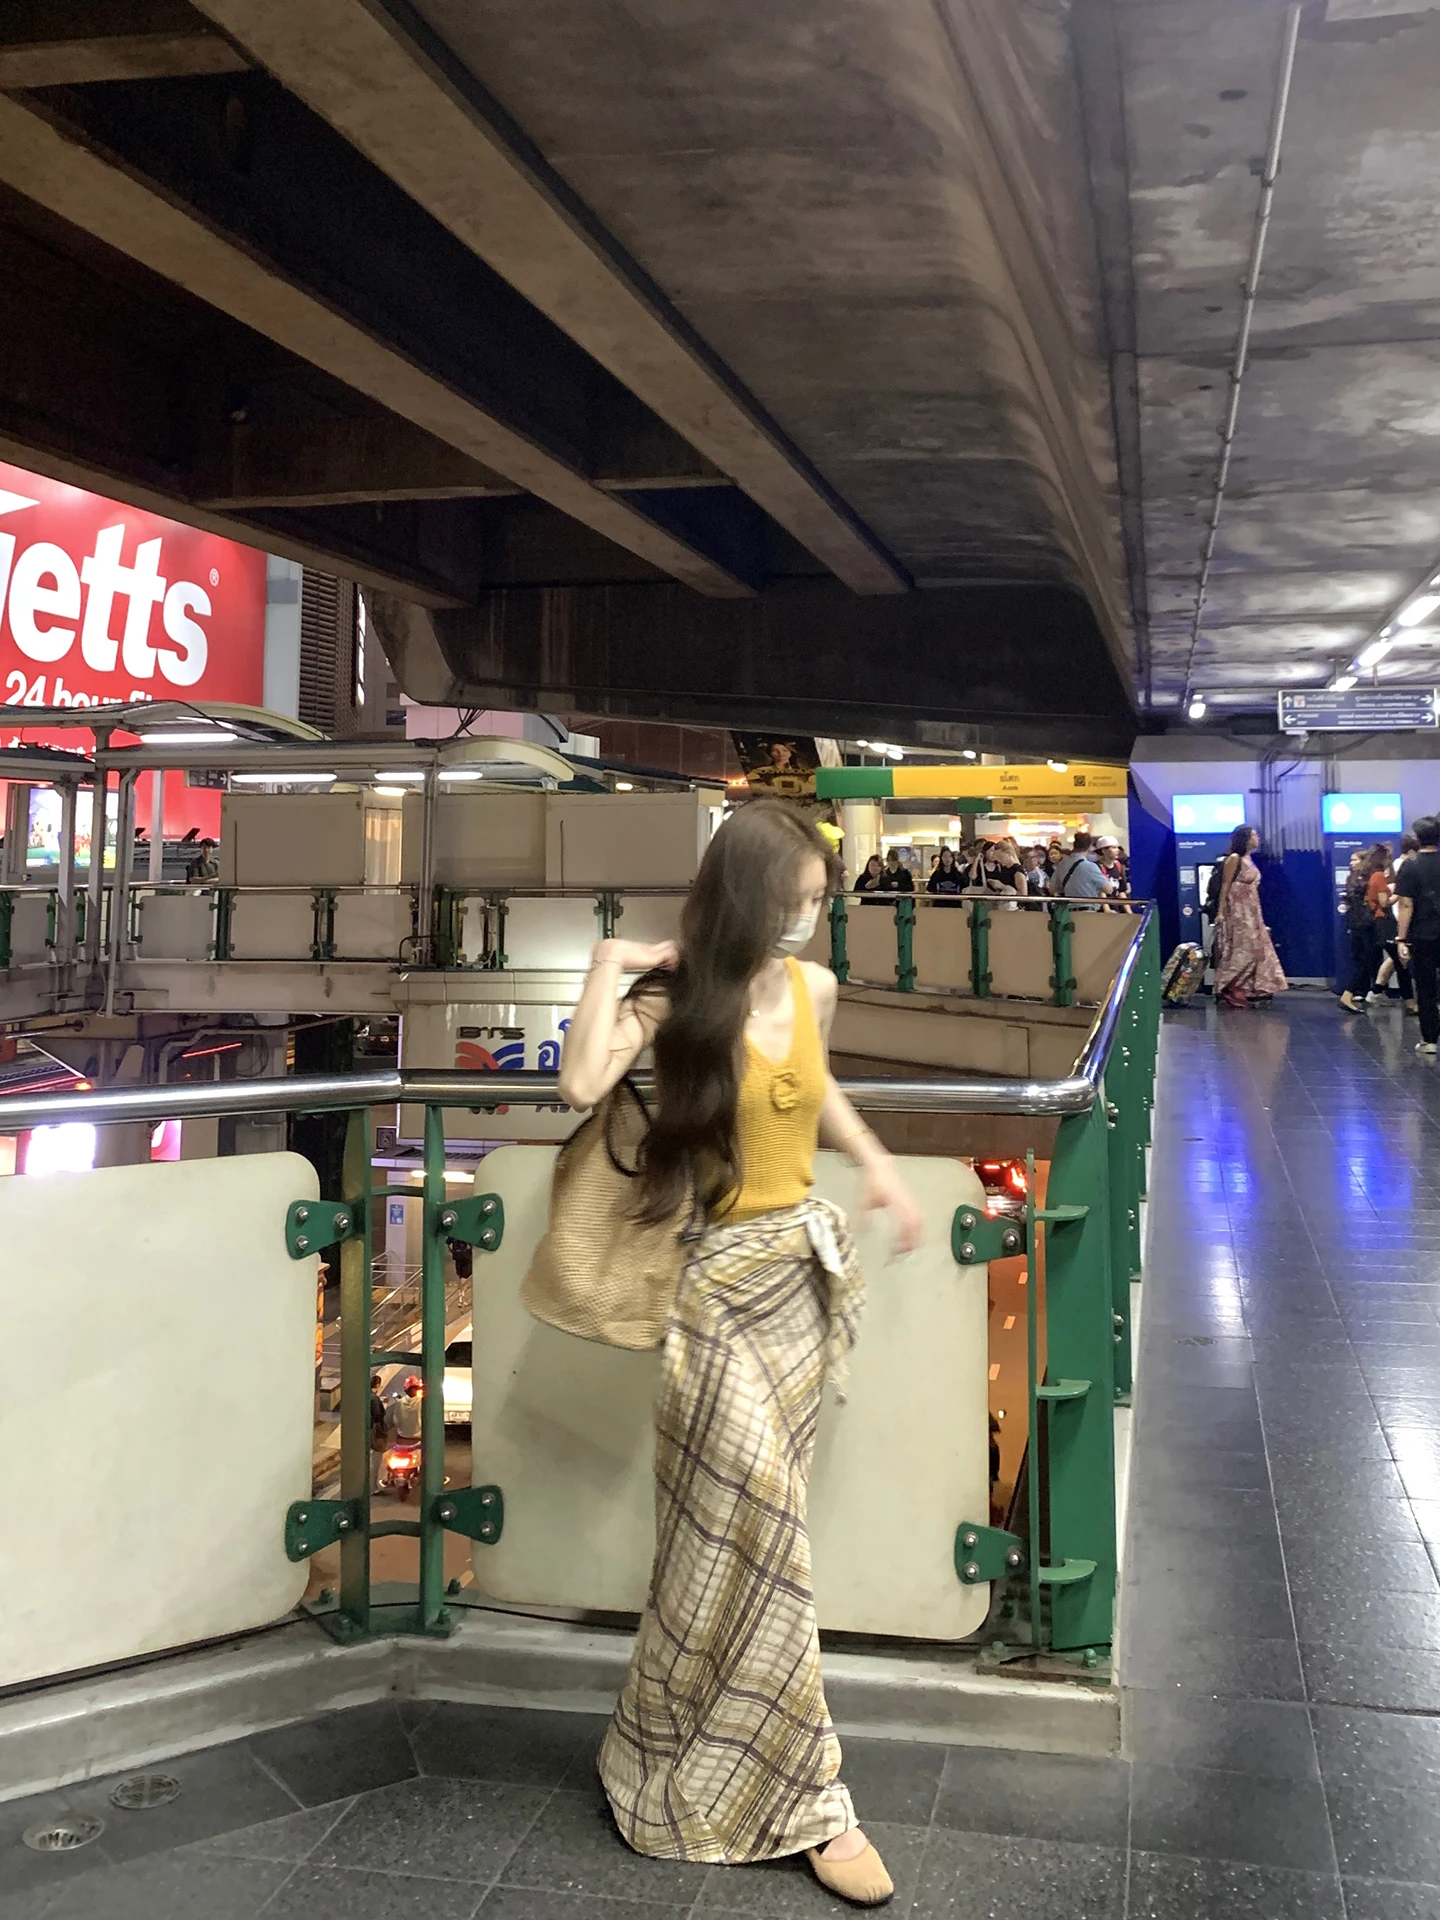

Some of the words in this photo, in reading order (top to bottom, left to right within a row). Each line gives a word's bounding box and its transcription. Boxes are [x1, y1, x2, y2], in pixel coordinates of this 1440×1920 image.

[0, 523, 212, 687] etts
[5, 670, 46, 706] 24
[456, 1026, 525, 1040] BTS
